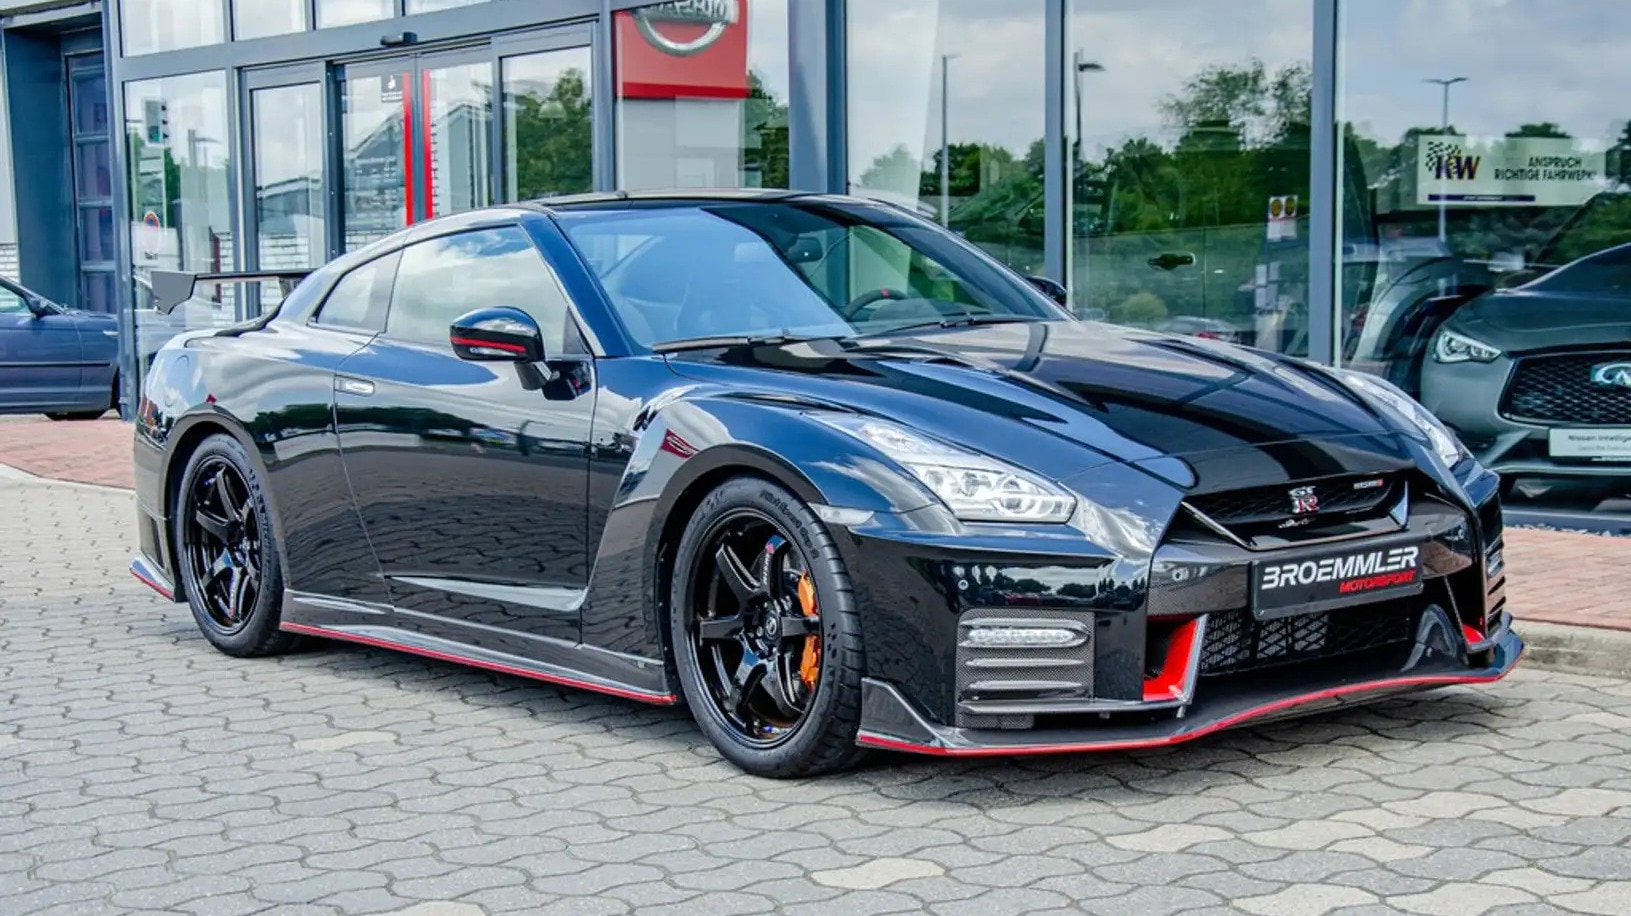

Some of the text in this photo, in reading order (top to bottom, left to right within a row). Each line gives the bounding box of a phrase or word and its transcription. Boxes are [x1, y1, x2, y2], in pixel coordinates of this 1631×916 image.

[1434, 156, 1480, 180] KW
[1528, 157, 1581, 168] ANSPRUCH
[1494, 169, 1539, 181] RICHTIGE
[1261, 546, 1419, 590] BROEMMLER
[1339, 570, 1416, 593] MOTORSPORT
